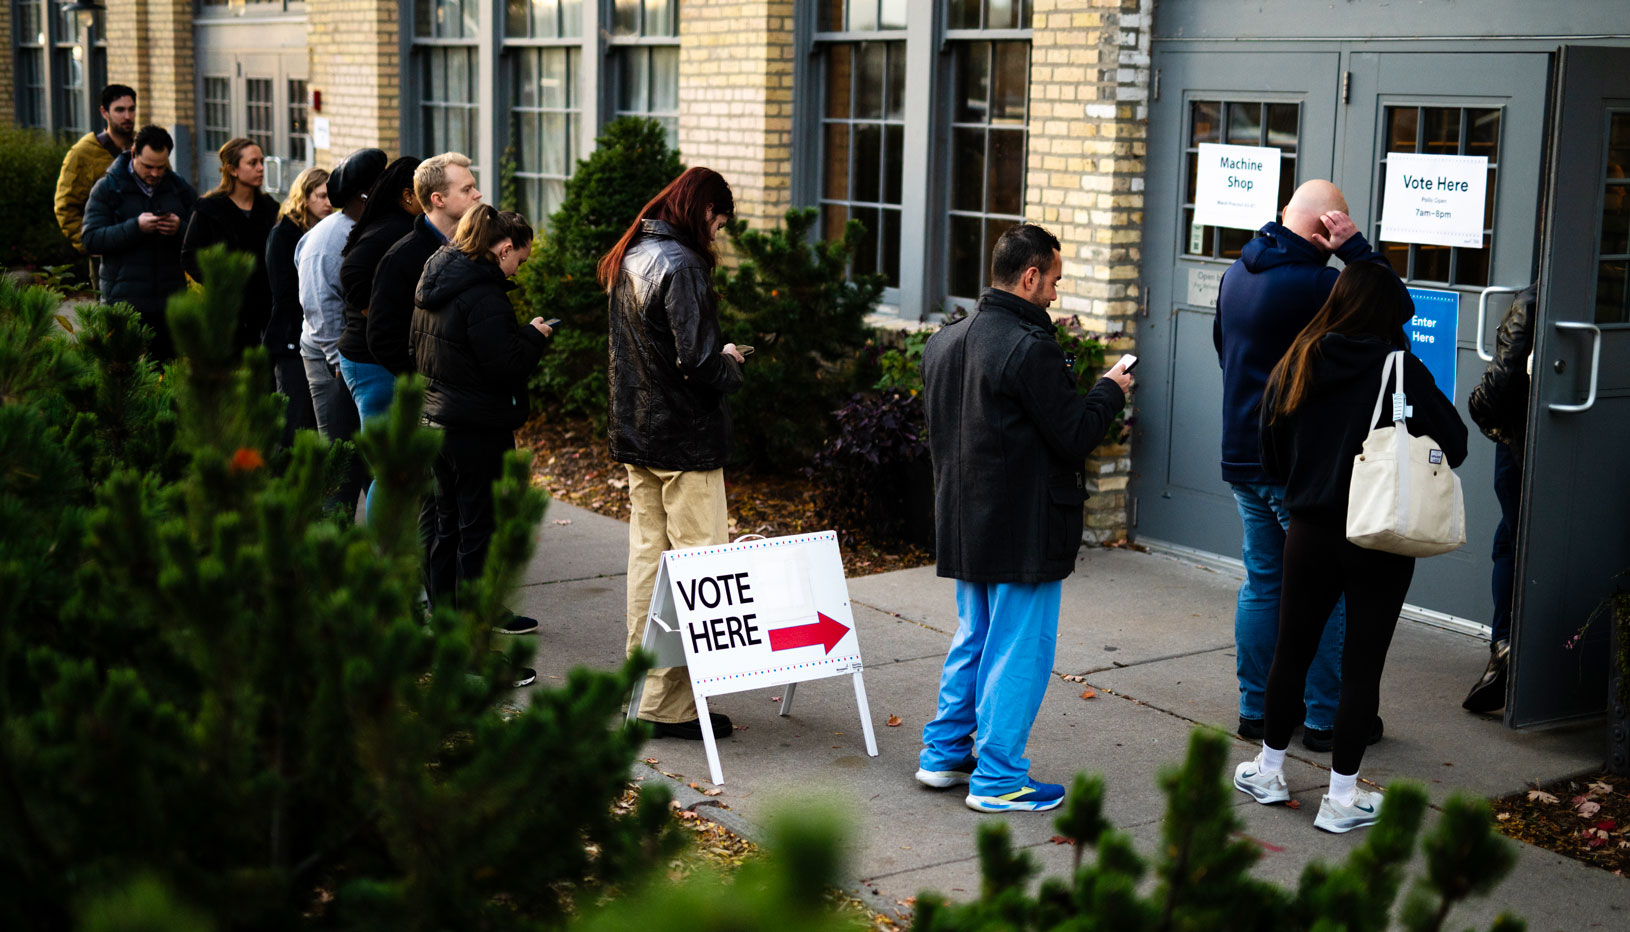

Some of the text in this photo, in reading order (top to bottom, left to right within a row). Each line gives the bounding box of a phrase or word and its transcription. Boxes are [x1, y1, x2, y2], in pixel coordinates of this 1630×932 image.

[1220, 156, 1263, 171] Machine
[1227, 175, 1254, 192] Shop
[1403, 174, 1469, 192] Vote Here
[1198, 271, 1215, 281] Open
[1411, 315, 1437, 328] Enter
[1412, 331, 1435, 344] Here
[676, 572, 754, 611] VOTE
[688, 613, 762, 653] HERE
